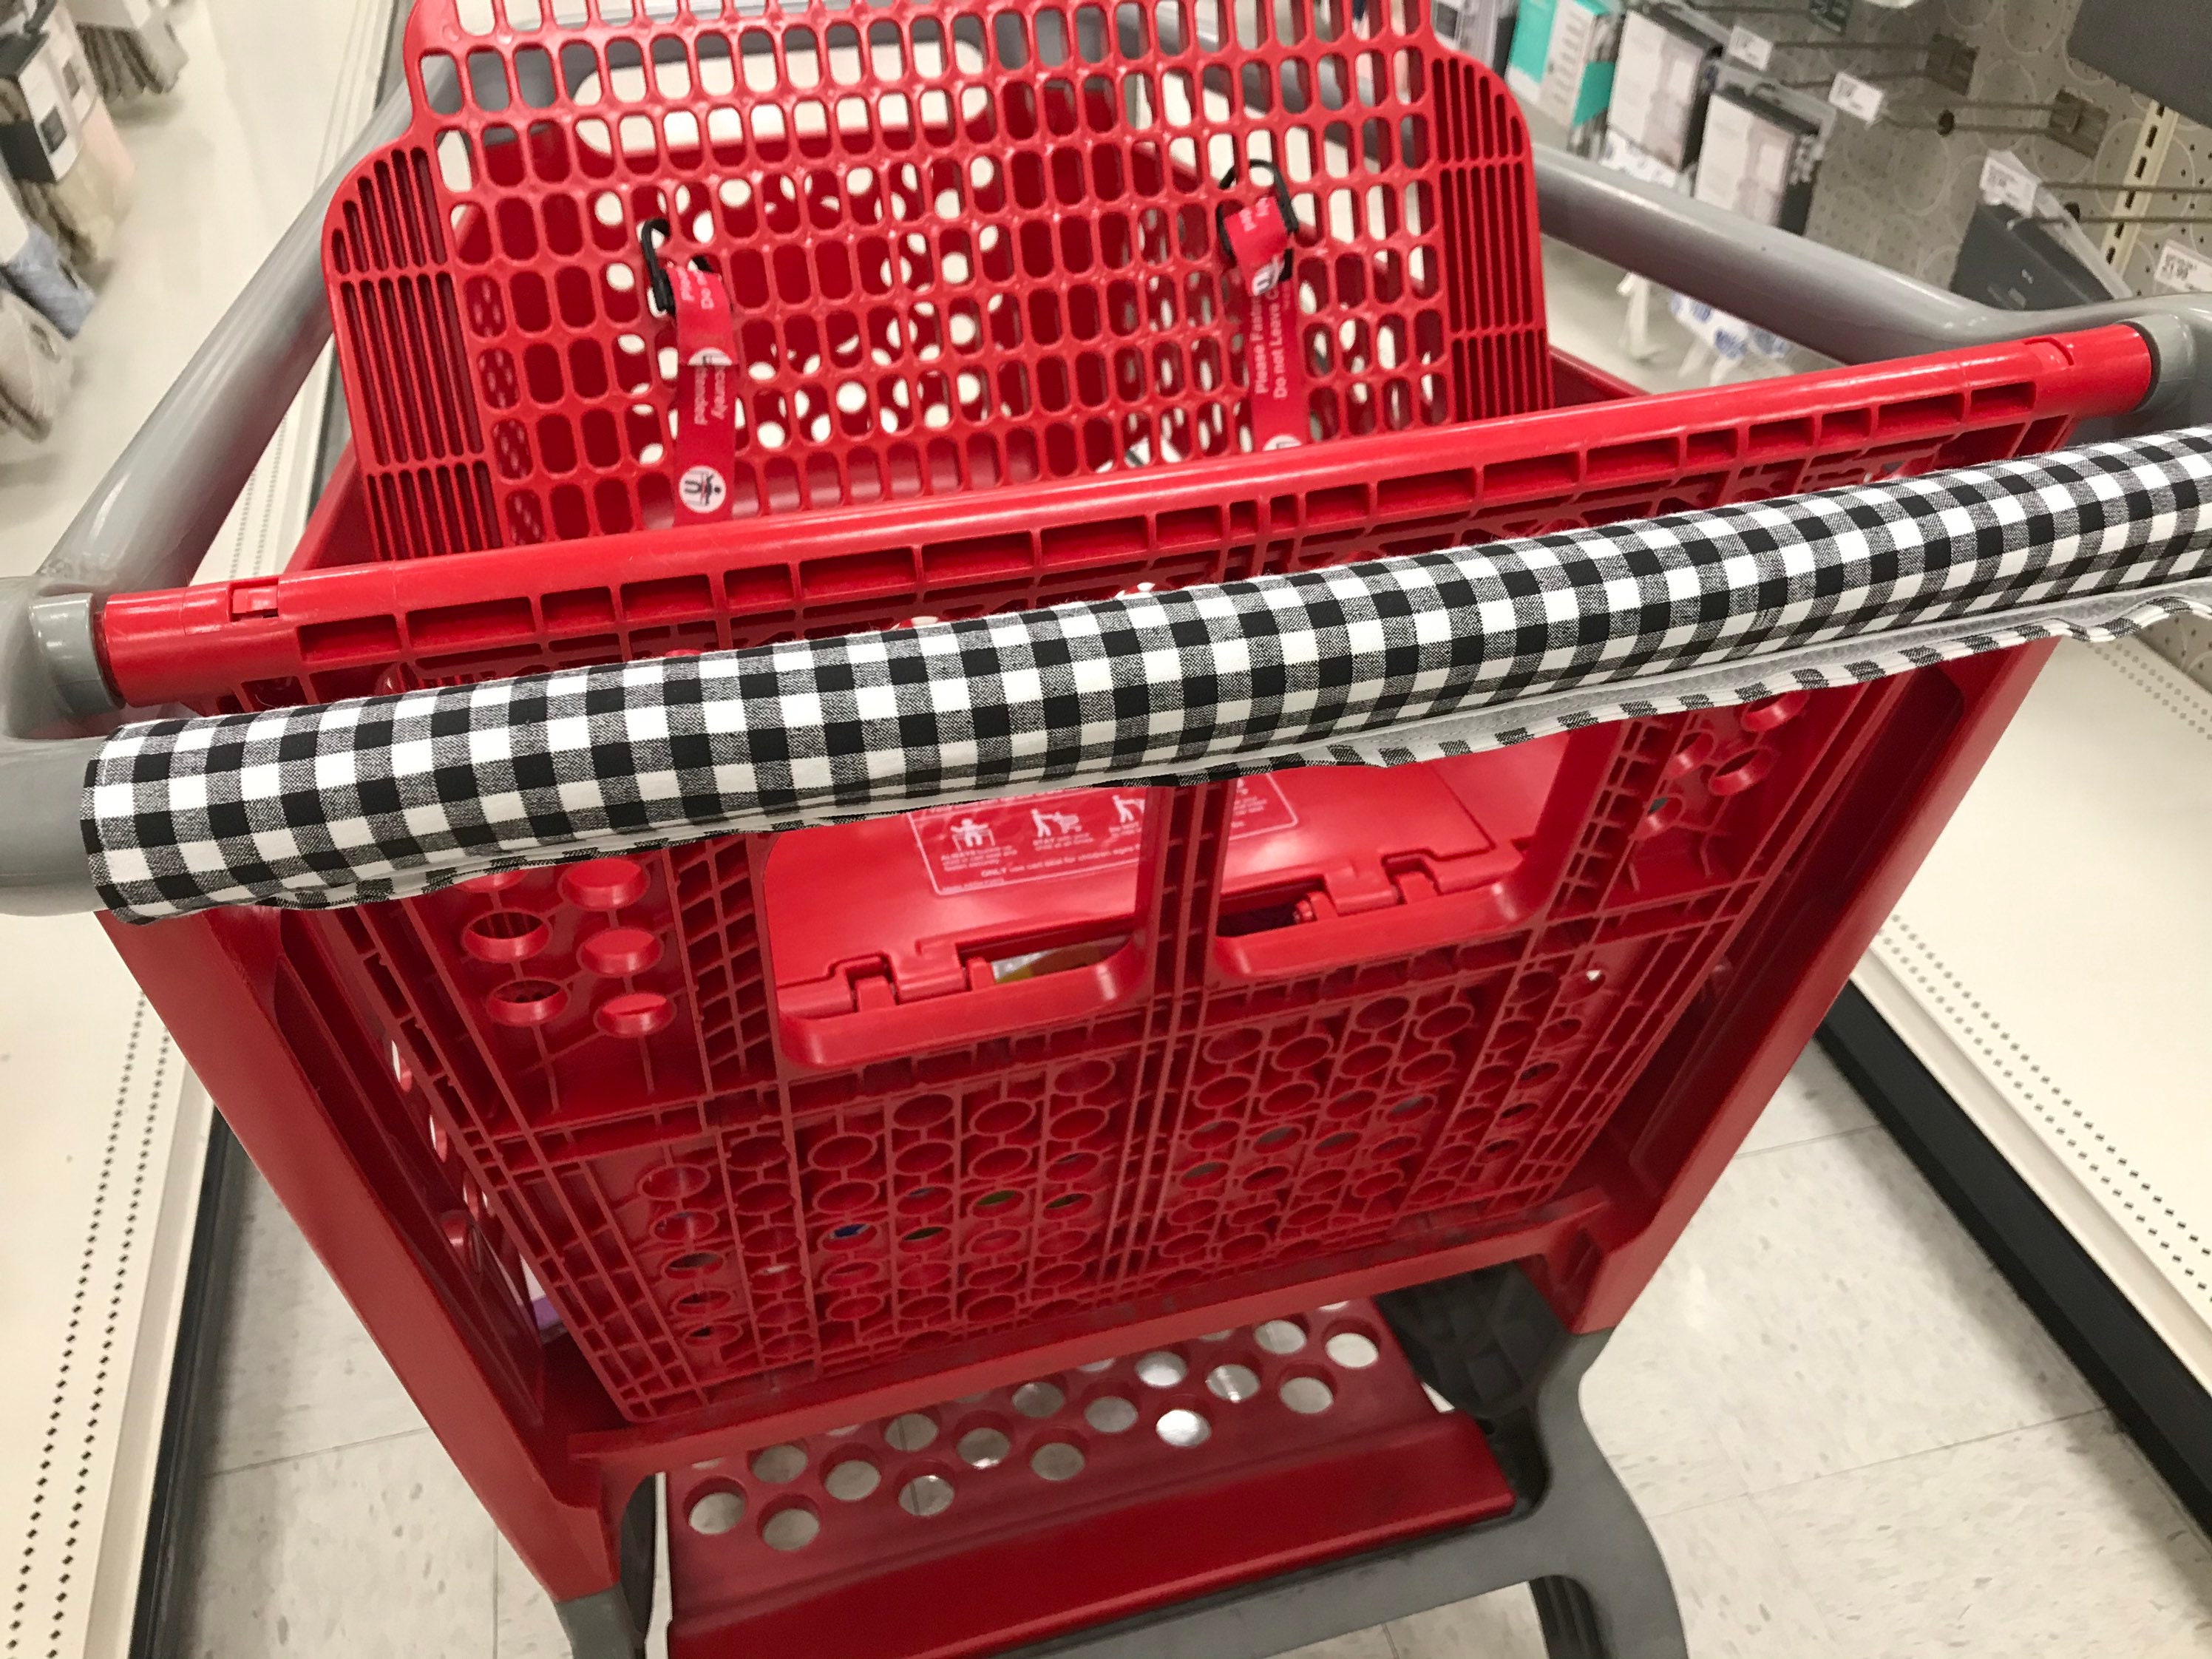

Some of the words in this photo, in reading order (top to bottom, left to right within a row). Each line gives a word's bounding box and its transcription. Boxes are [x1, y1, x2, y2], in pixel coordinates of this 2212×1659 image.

[700, 288, 714, 309] Do
[1269, 303, 1283, 346] Leave
[1254, 345, 1269, 394] Please
[1271, 348, 1285, 373] not
[1273, 376, 1288, 400] Do
